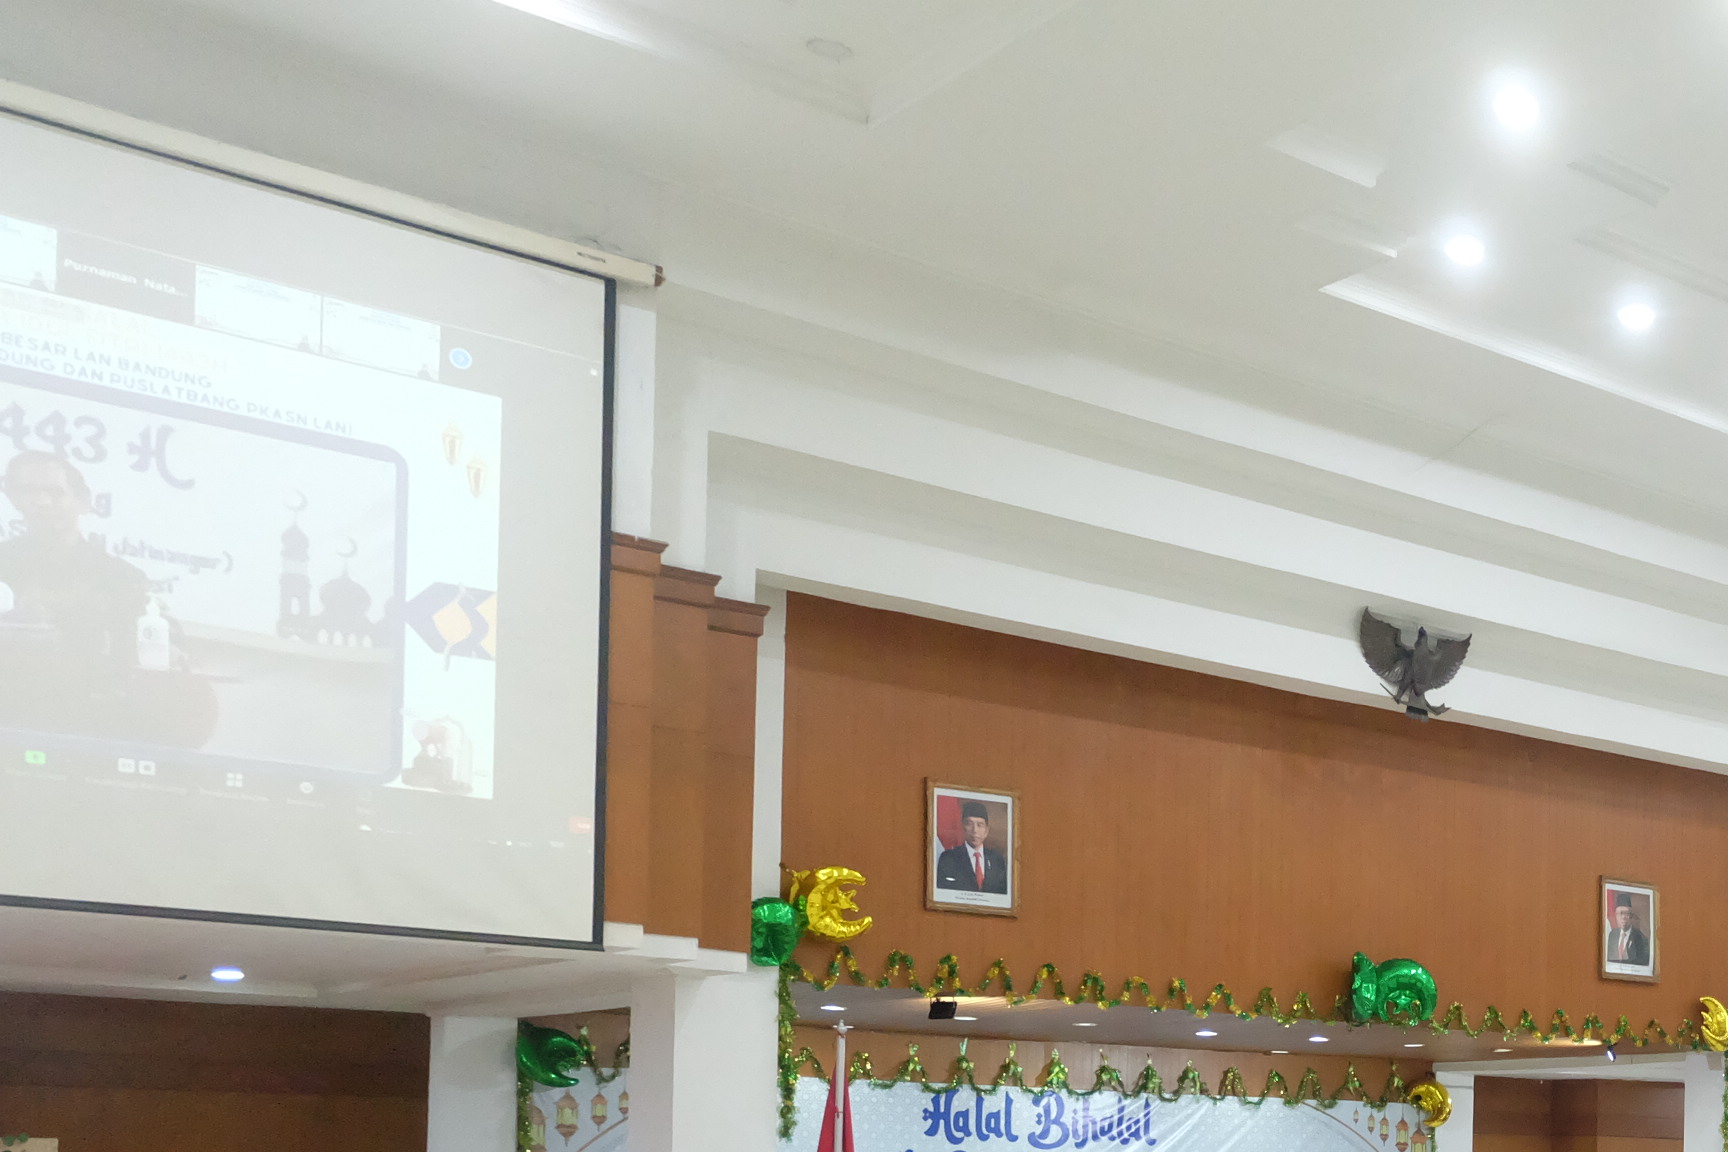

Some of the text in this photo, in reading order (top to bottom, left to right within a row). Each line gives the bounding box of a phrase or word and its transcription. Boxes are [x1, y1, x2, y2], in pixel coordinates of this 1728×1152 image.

[63, 362, 104, 382] DAN
[74, 347, 112, 367] LAN
[117, 357, 212, 389] BANDUNG
[922, 1088, 1157, 1150] Halal Bihalal
